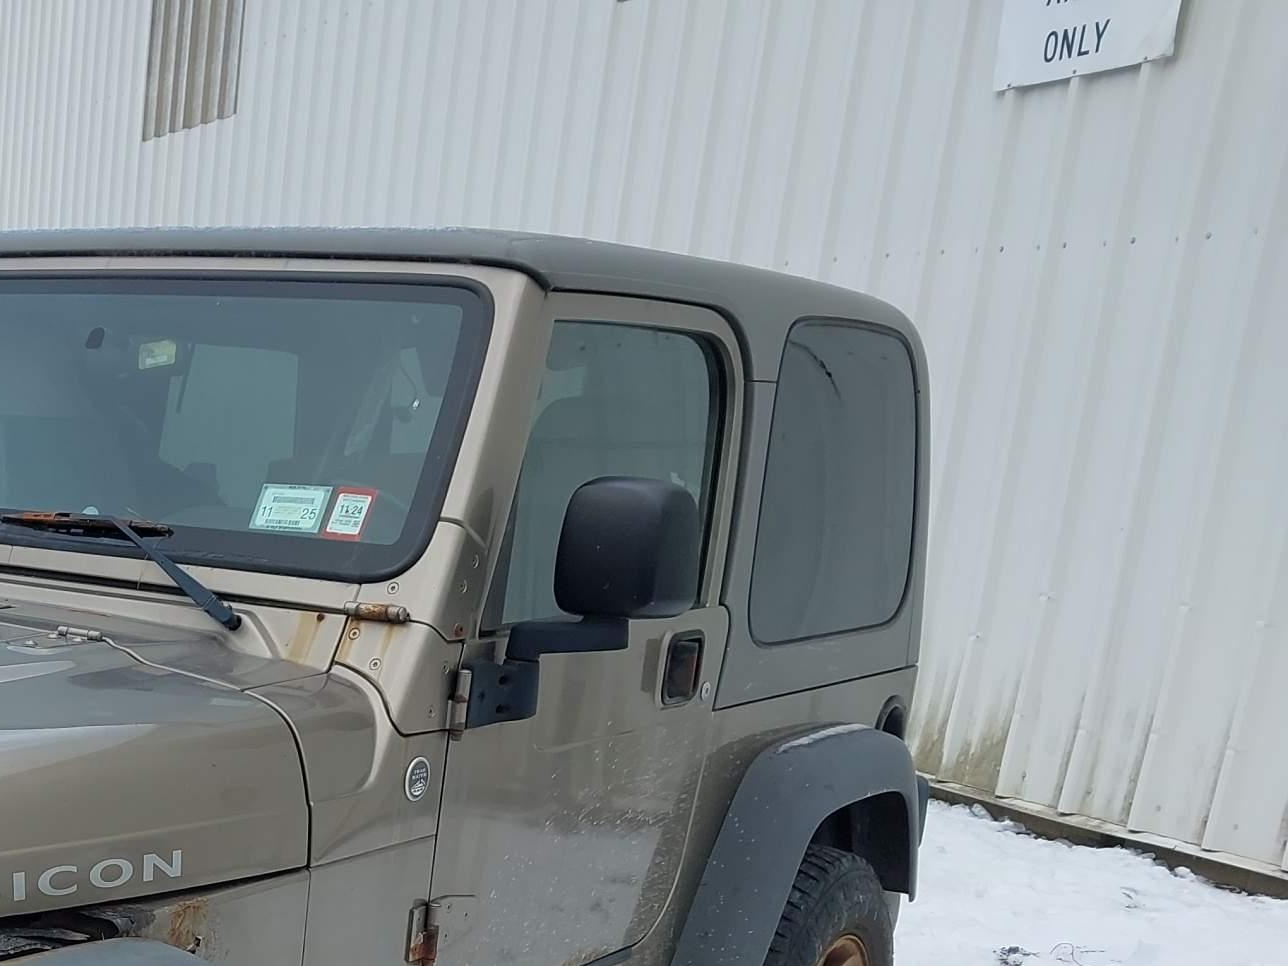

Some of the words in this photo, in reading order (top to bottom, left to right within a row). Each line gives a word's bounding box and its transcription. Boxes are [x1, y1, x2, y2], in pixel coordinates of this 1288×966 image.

[1043, 18, 1111, 63] ONLY
[261, 505, 273, 518] 11
[300, 507, 318, 520] 25
